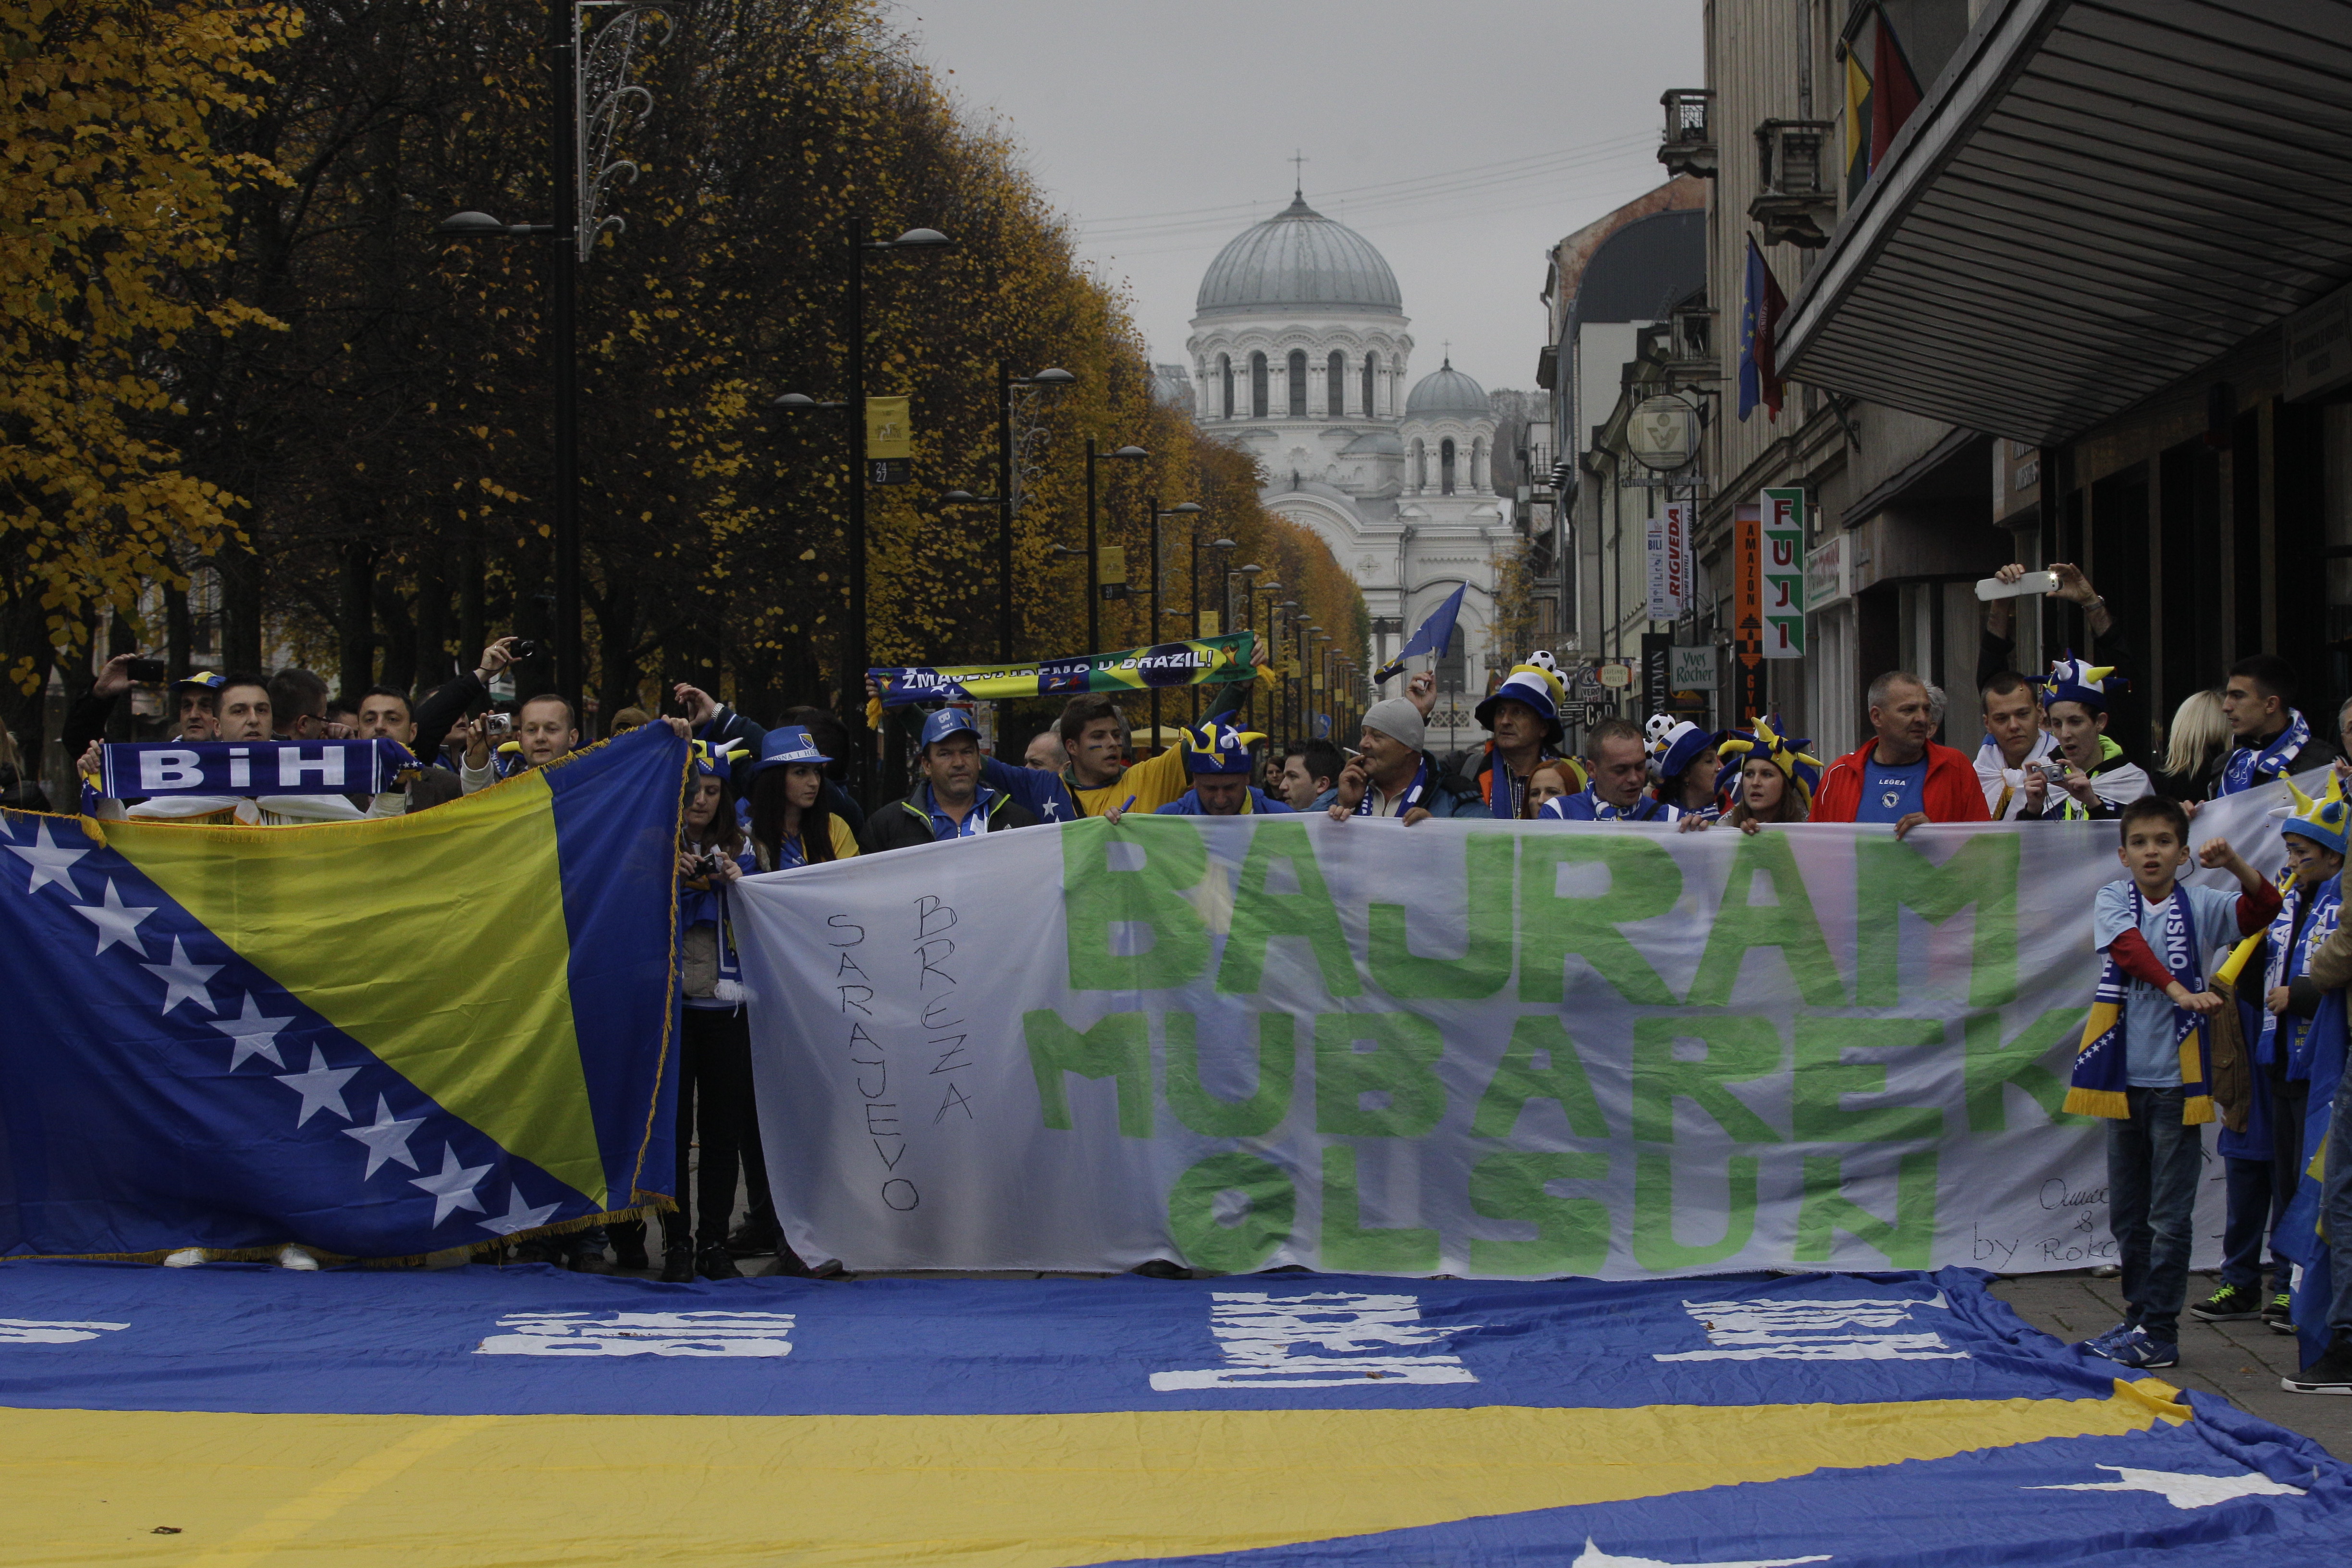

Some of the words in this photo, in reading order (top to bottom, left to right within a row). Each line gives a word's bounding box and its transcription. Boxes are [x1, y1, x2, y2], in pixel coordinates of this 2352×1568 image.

[876, 462, 887, 471] 24
[876, 471, 887, 482] 27
[1668, 509, 1680, 597] RIGVEDA
[1745, 525, 1756, 605] AMAZON
[1773, 499, 1793, 649] FUJI
[1097, 659, 1115, 672] U
[1120, 649, 1214, 671] BRAZIL!
[1652, 650, 1665, 715] BALTMAN
[1677, 667, 1714, 683] Rocher
[1683, 652, 1706, 668] Yves
[1581, 687, 1600, 696] VERO
[1745, 674, 1757, 720] GYM
[139, 746, 345, 789] BiH
[1062, 814, 2022, 1007] BAJRAM
[913, 894, 973, 1126] BREZA
[827, 913, 919, 1211] SARAJEVO
[1022, 1007, 2095, 1146] MUBAREK
[1167, 1143, 1940, 1277] OLSUN
[1973, 1222, 2019, 1270] by
